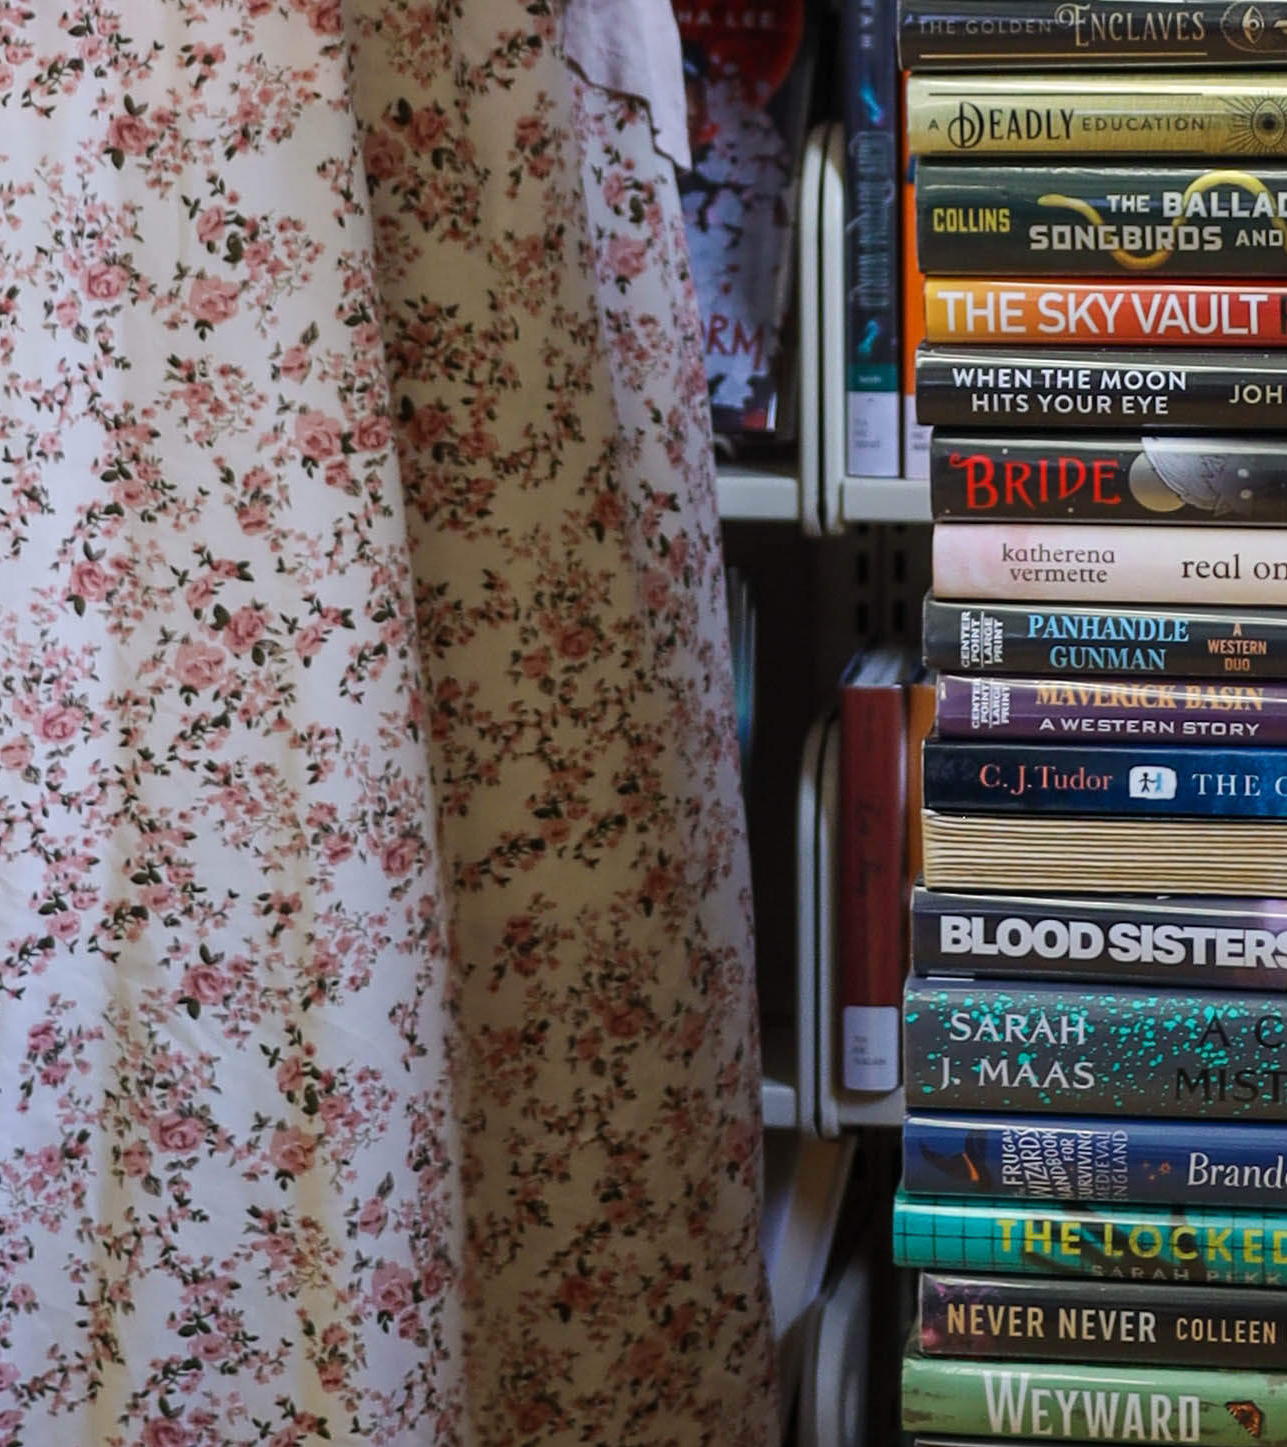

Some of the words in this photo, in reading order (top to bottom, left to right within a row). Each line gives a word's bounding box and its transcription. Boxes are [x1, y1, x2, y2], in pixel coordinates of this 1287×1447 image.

[966, 18, 1053, 34] GOLDEN
[929, 119, 939, 130] A
[1082, 116, 1204, 132] EDUCATION
[1107, 195, 1149, 213] THE
[933, 207, 1009, 232] COLLINS
[1029, 226, 1221, 251] SONGBIRDS
[1236, 229, 1282, 247] AND
[938, 291, 1024, 333] THE
[1037, 292, 1125, 334] SKY
[1129, 294, 1268, 334] VAULT
[952, 368, 1034, 390] WHEN
[1041, 369, 1093, 390] THE
[1100, 370, 1187, 391] MOON
[971, 393, 1030, 414] HITS
[1038, 394, 1113, 415] YOUR
[1121, 395, 1168, 414] EYE
[1002, 544, 1115, 563] katherena
[1182, 554, 1241, 580] real
[1010, 567, 1108, 583] vermette
[1028, 615, 1190, 642] PANHANDLE
[1049, 646, 1167, 670] GUNMAN
[1208, 639, 1267, 655] WESTERN
[1225, 658, 1250, 672] DUO
[1040, 718, 1055, 731] A
[1061, 718, 1175, 734] WESTERN
[1182, 721, 1259, 736] STORY
[940, 915, 1103, 959] BLOOD
[950, 1013, 1085, 1045] SARAH
[947, 1304, 1045, 1339] NEVER
[1058, 1308, 1157, 1344] NEVER
[1176, 1317, 1277, 1345] COLLEEN
